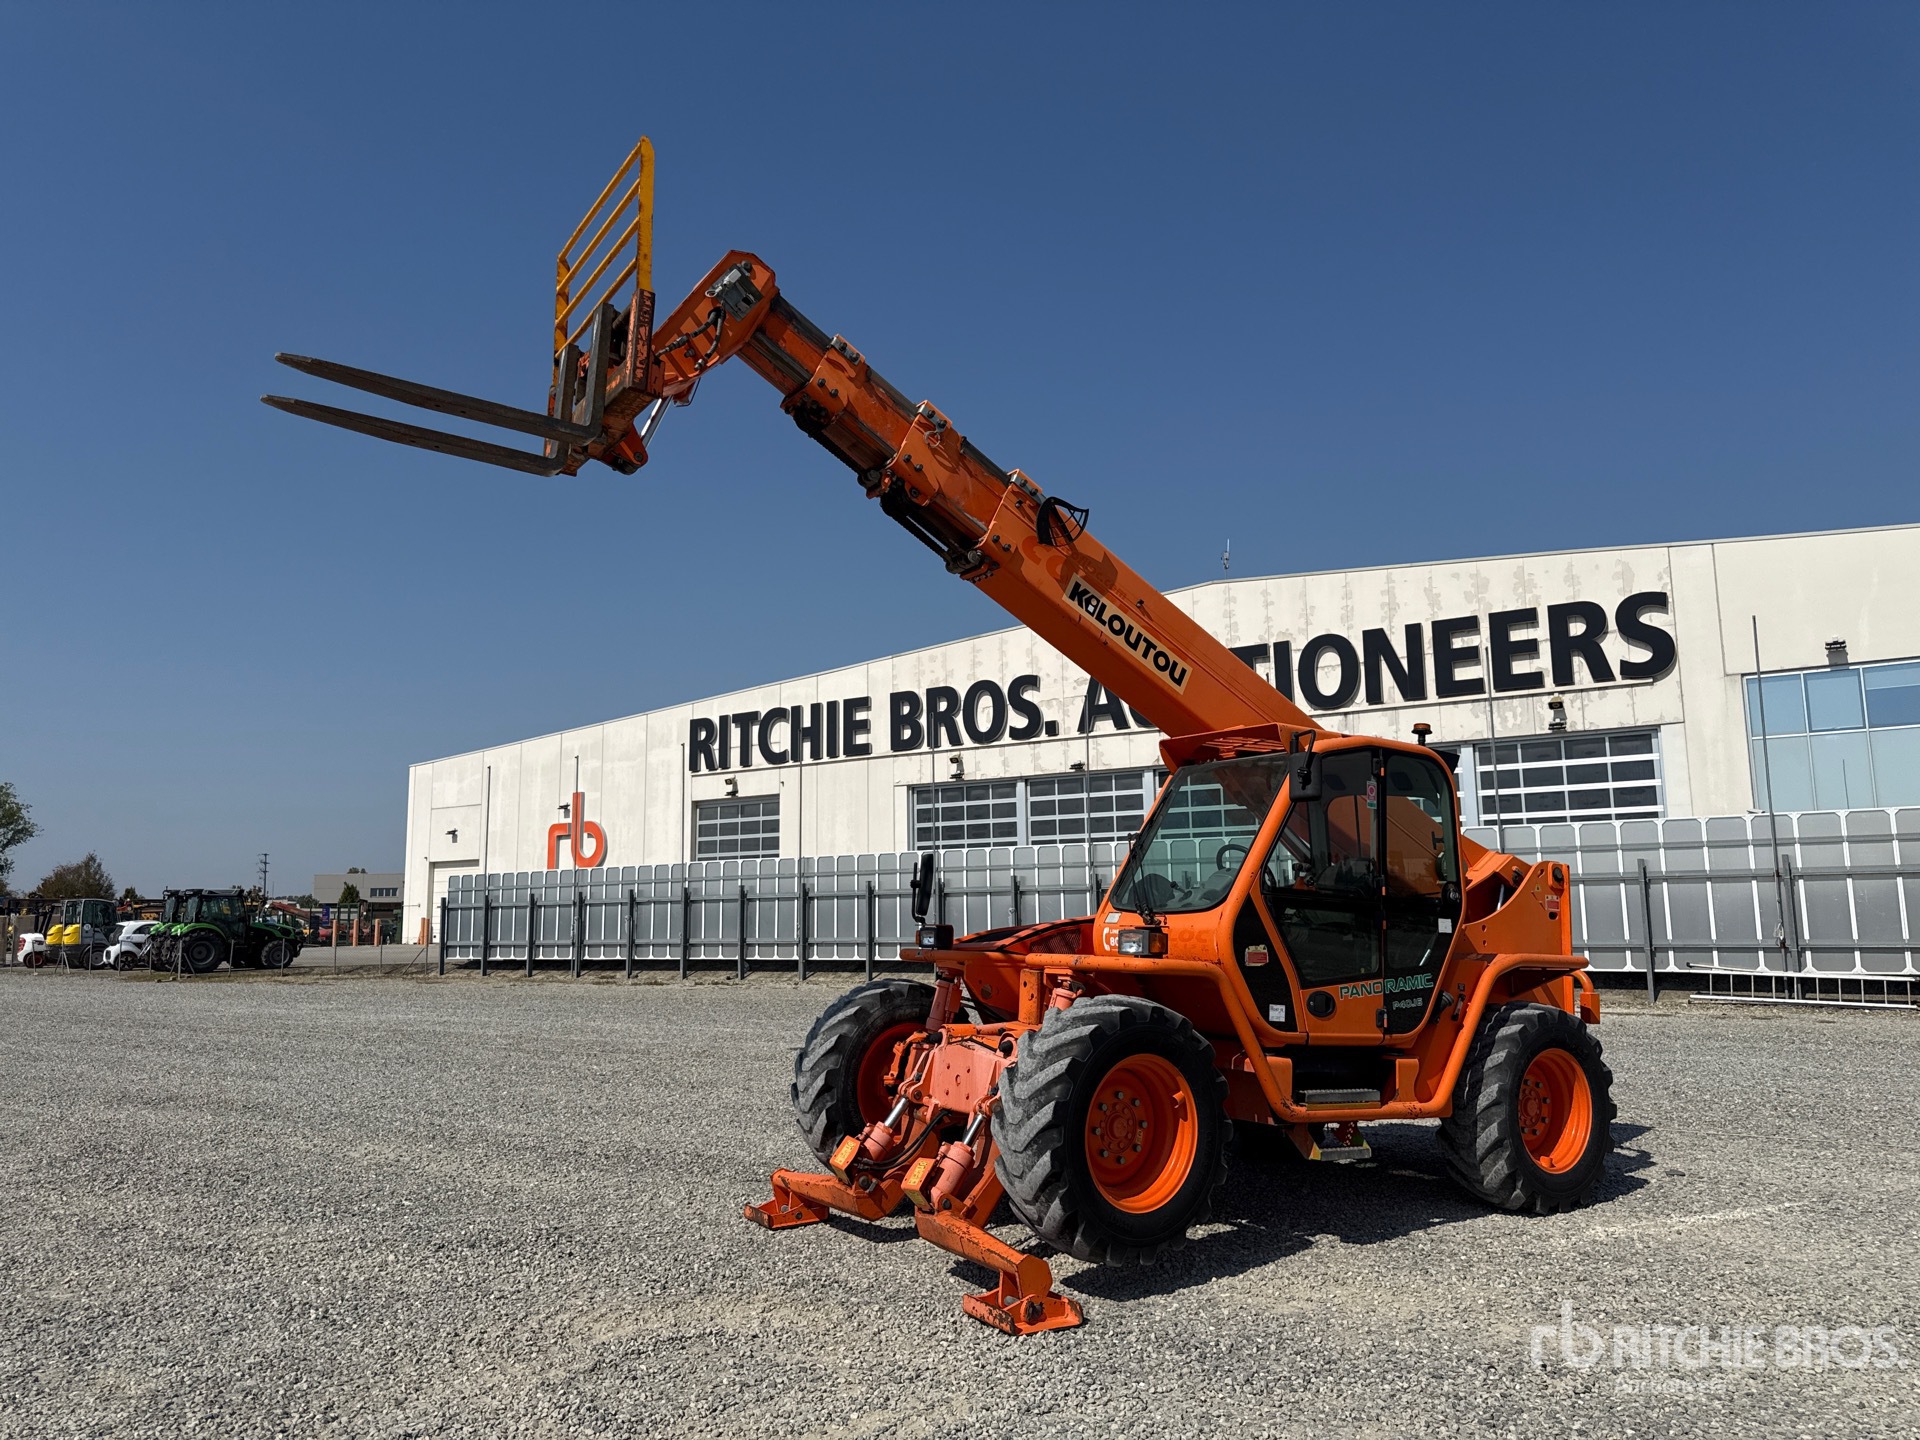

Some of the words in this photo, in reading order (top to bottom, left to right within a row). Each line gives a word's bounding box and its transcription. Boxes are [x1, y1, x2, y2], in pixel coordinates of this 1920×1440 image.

[689, 696, 872, 773] RITCHIE
[890, 674, 1059, 752] BROS.
[1077, 591, 1677, 734] AIONEERS
[547, 791, 608, 869] rb
[1339, 973, 1434, 1000] PANORAMIC
